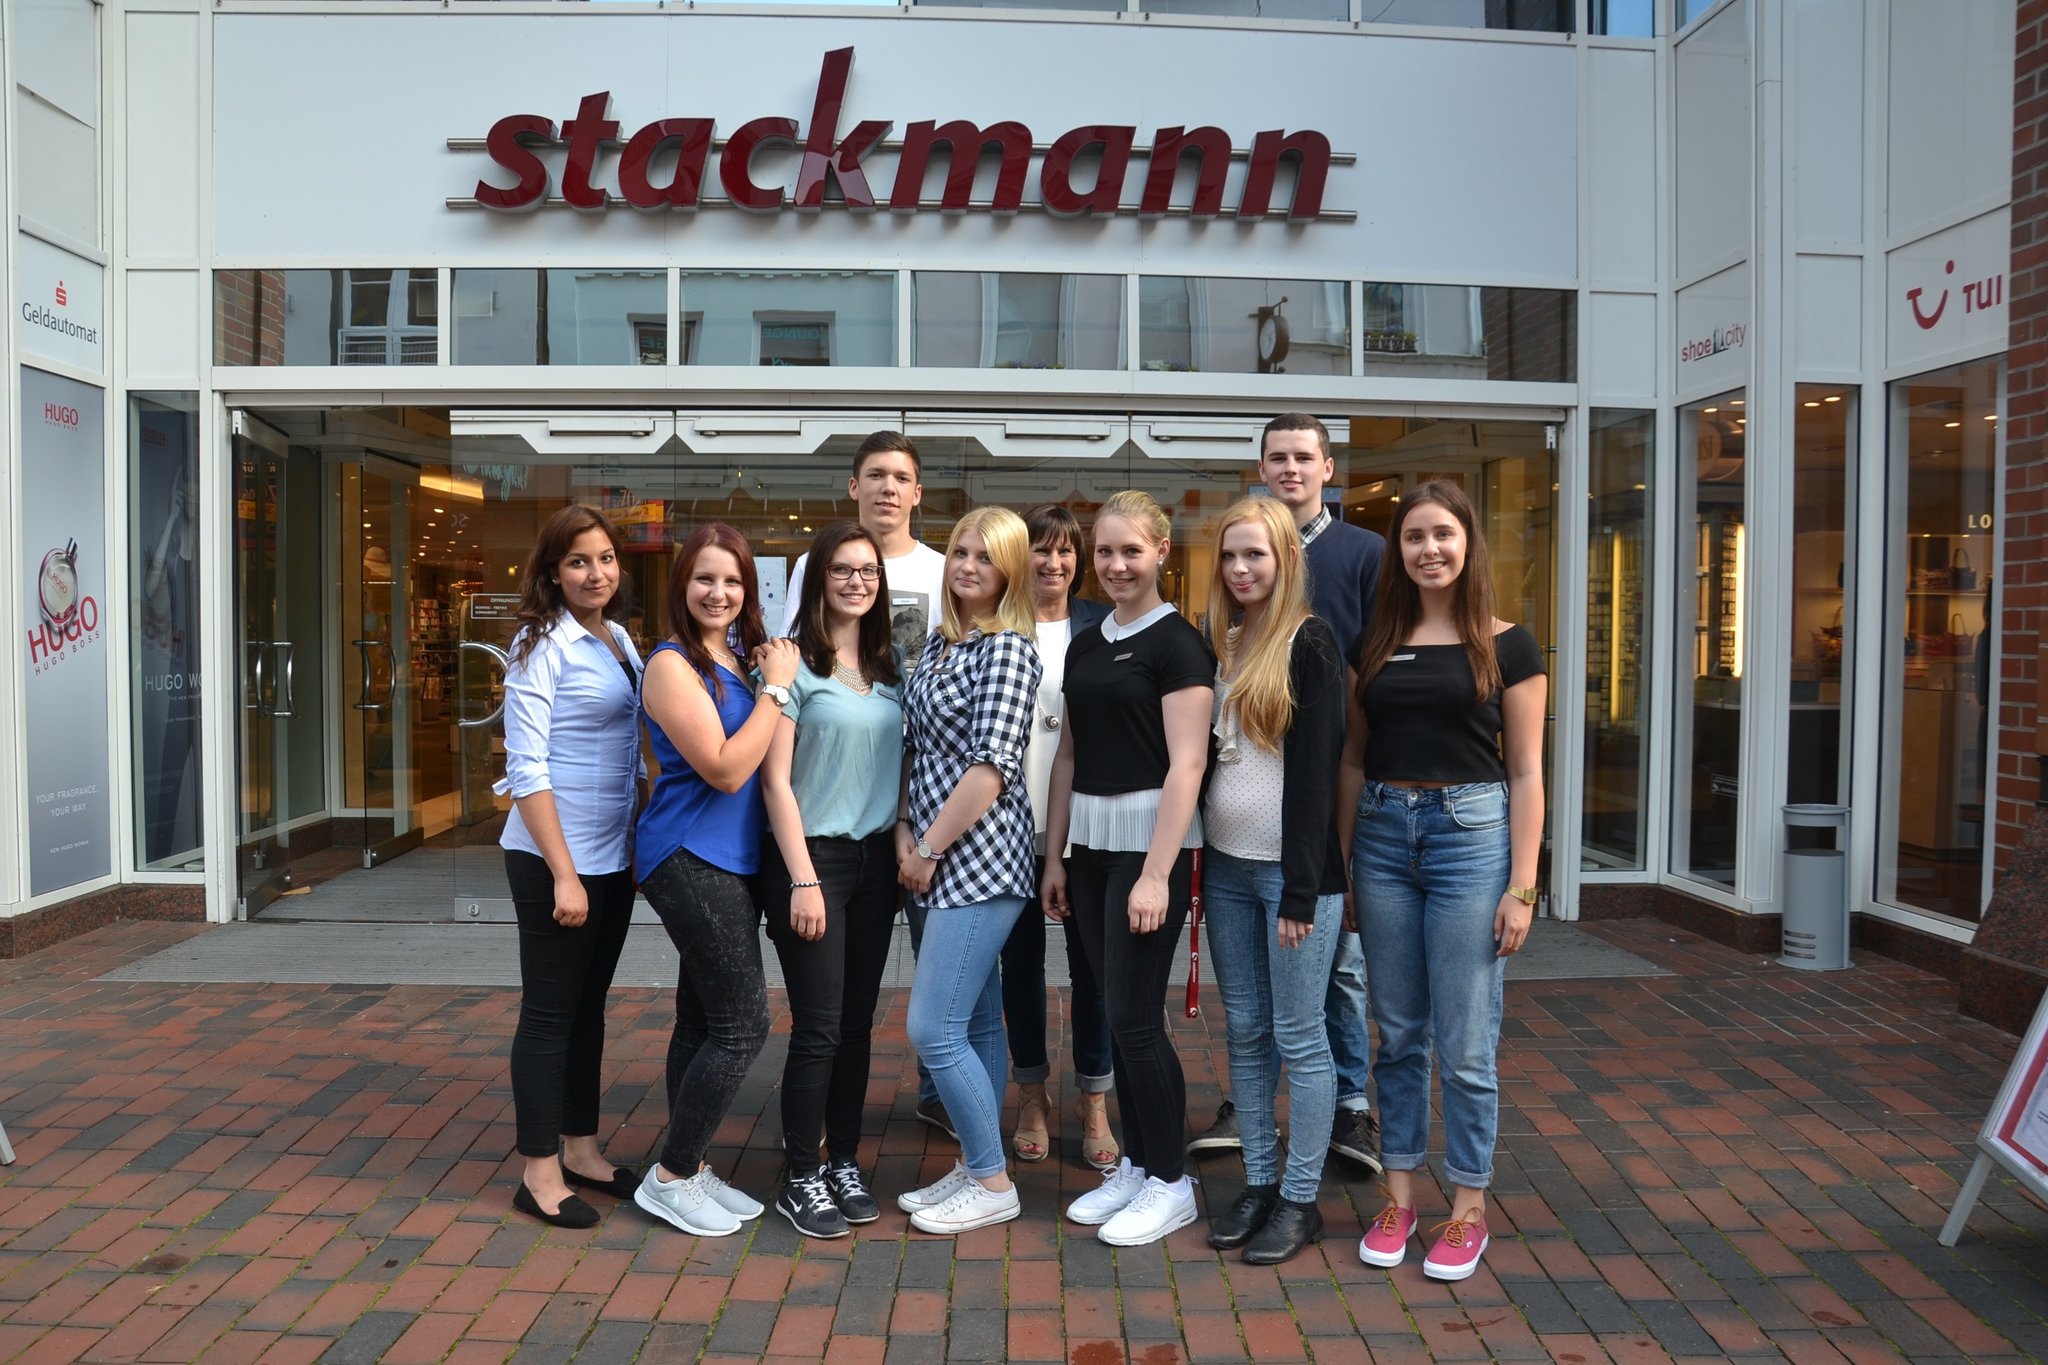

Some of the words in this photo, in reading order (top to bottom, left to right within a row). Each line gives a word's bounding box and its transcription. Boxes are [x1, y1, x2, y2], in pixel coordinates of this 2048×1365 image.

[473, 46, 1332, 221] stackmann
[1963, 274, 2002, 313] TUI
[22, 302, 97, 344] Geldautomat
[1681, 338, 1711, 362] shoe
[1725, 323, 1747, 348] city
[45, 402, 78, 425] HUGO
[28, 596, 98, 664] HUGO
[35, 652, 65, 676] HUGO
[72, 630, 101, 653] BOSS
[145, 674, 183, 692] HUGO
[36, 792, 55, 804] YOUR
[51, 805, 70, 817] YOUR
[72, 802, 87, 813] WAY
